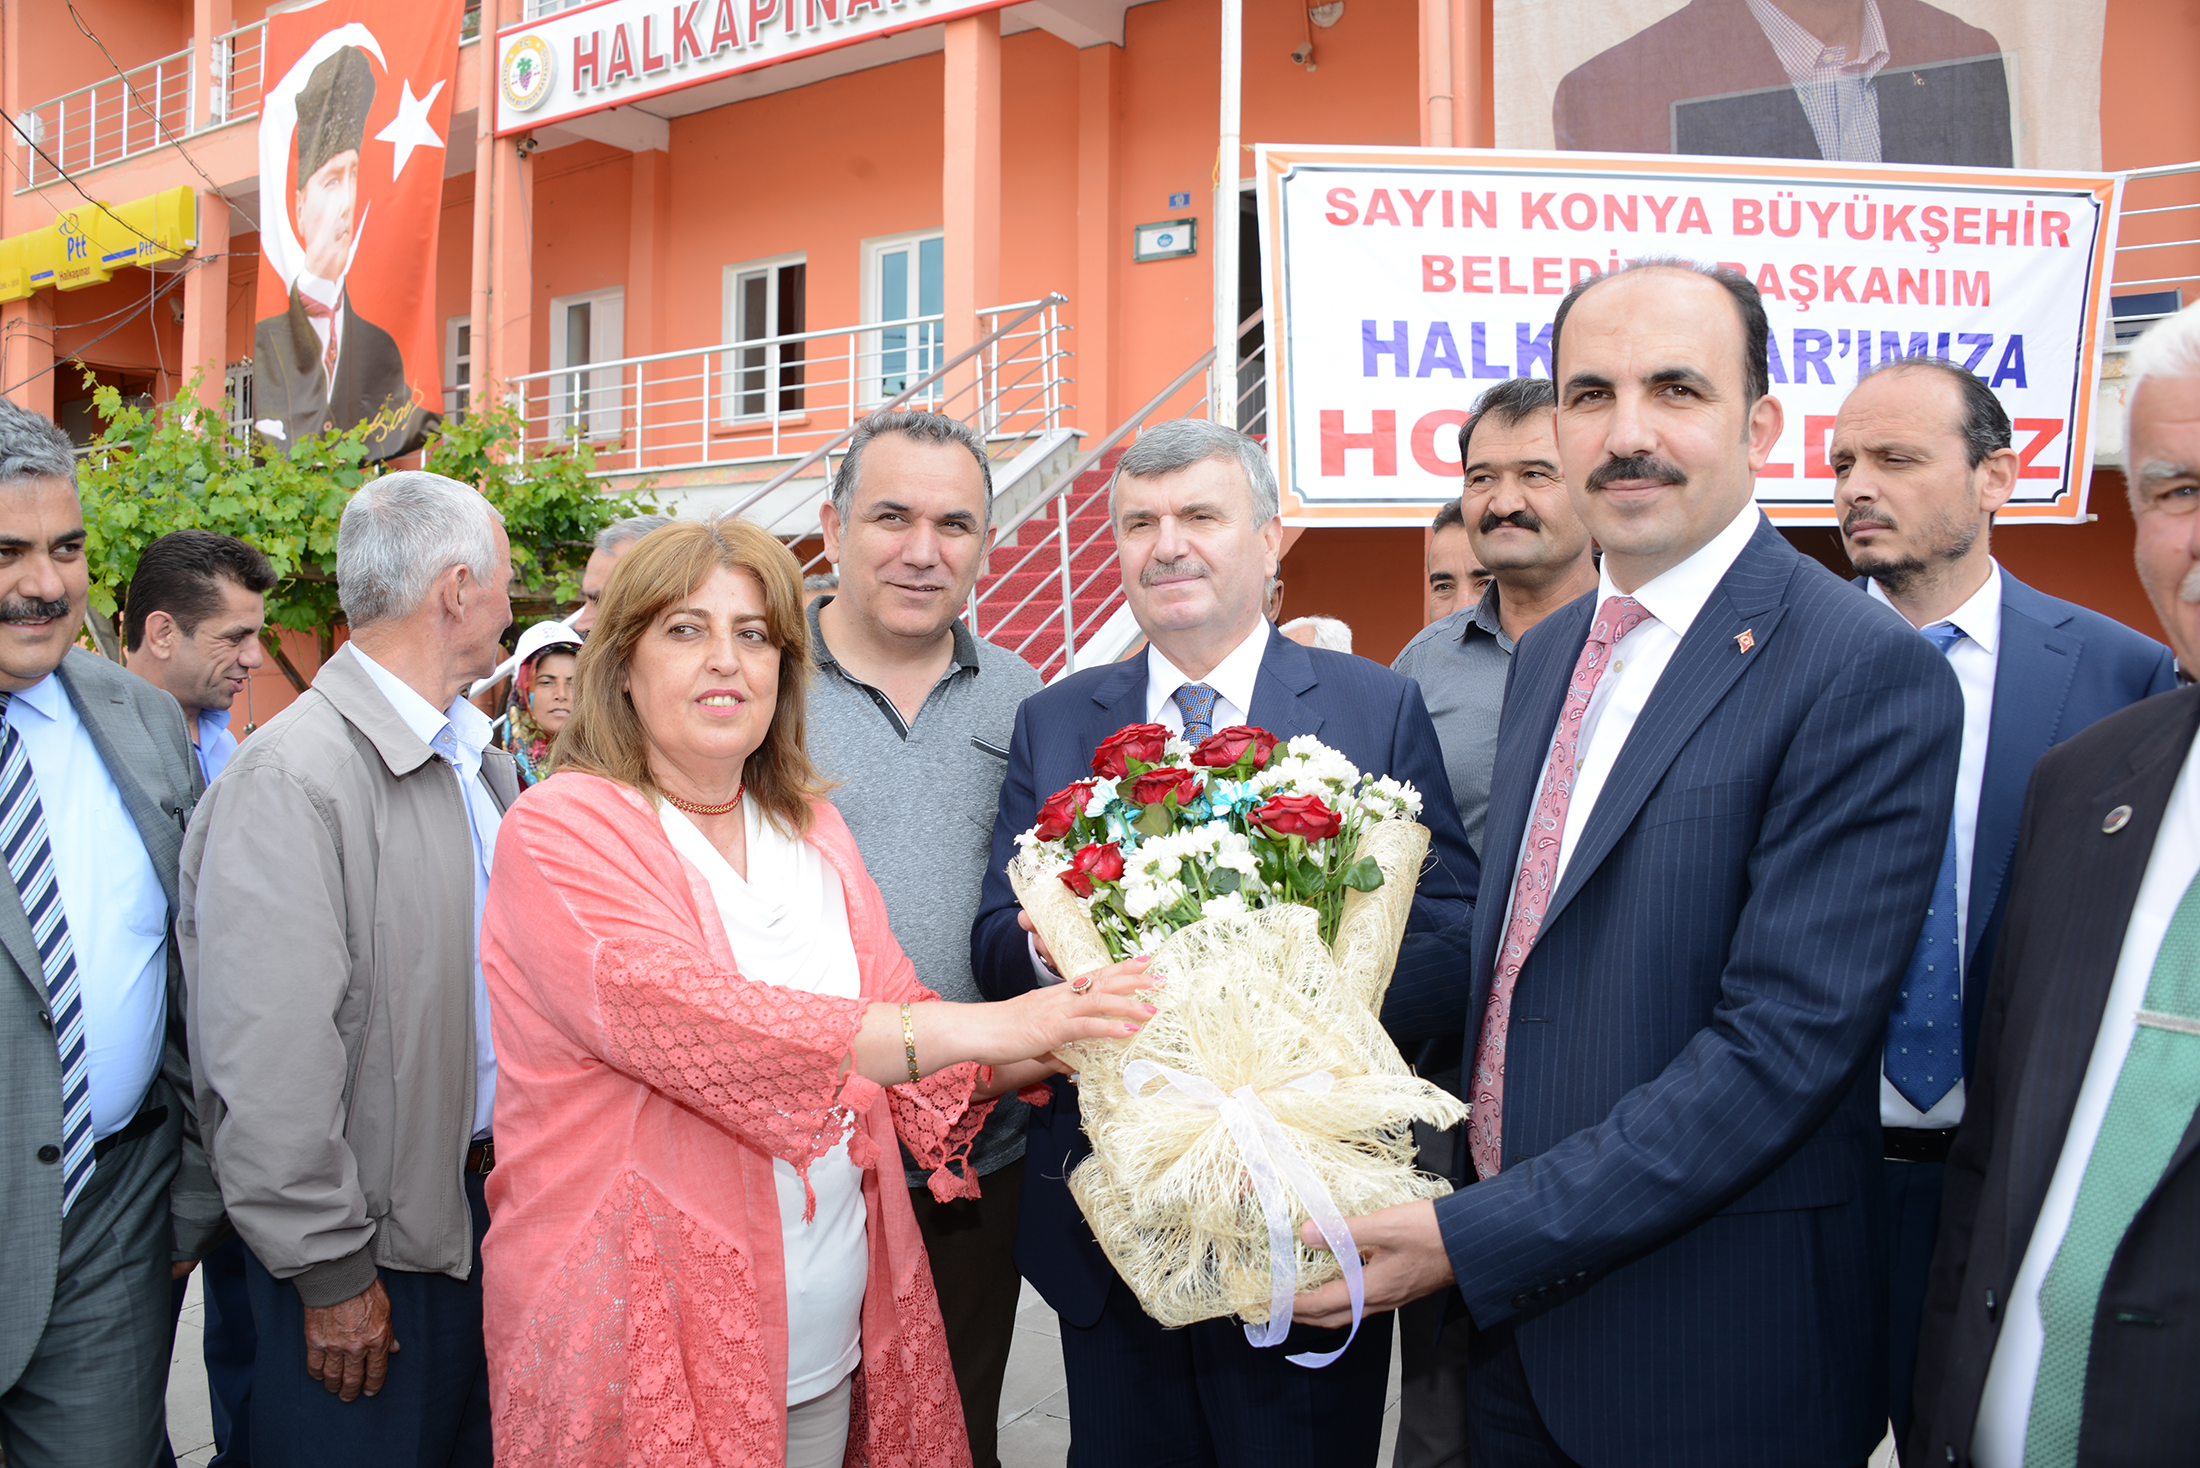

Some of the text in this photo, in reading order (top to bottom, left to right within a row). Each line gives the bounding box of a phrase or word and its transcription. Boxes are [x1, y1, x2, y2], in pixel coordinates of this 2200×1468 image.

[572, 0, 903, 95] HALKAPIN
[67, 234, 87, 262] Ptt
[1325, 187, 2072, 253] SAYIN KONYA BÜYÜKŞEHİR
[1421, 249, 1695, 295] BELEDİ
[1319, 409, 1467, 477] HO
